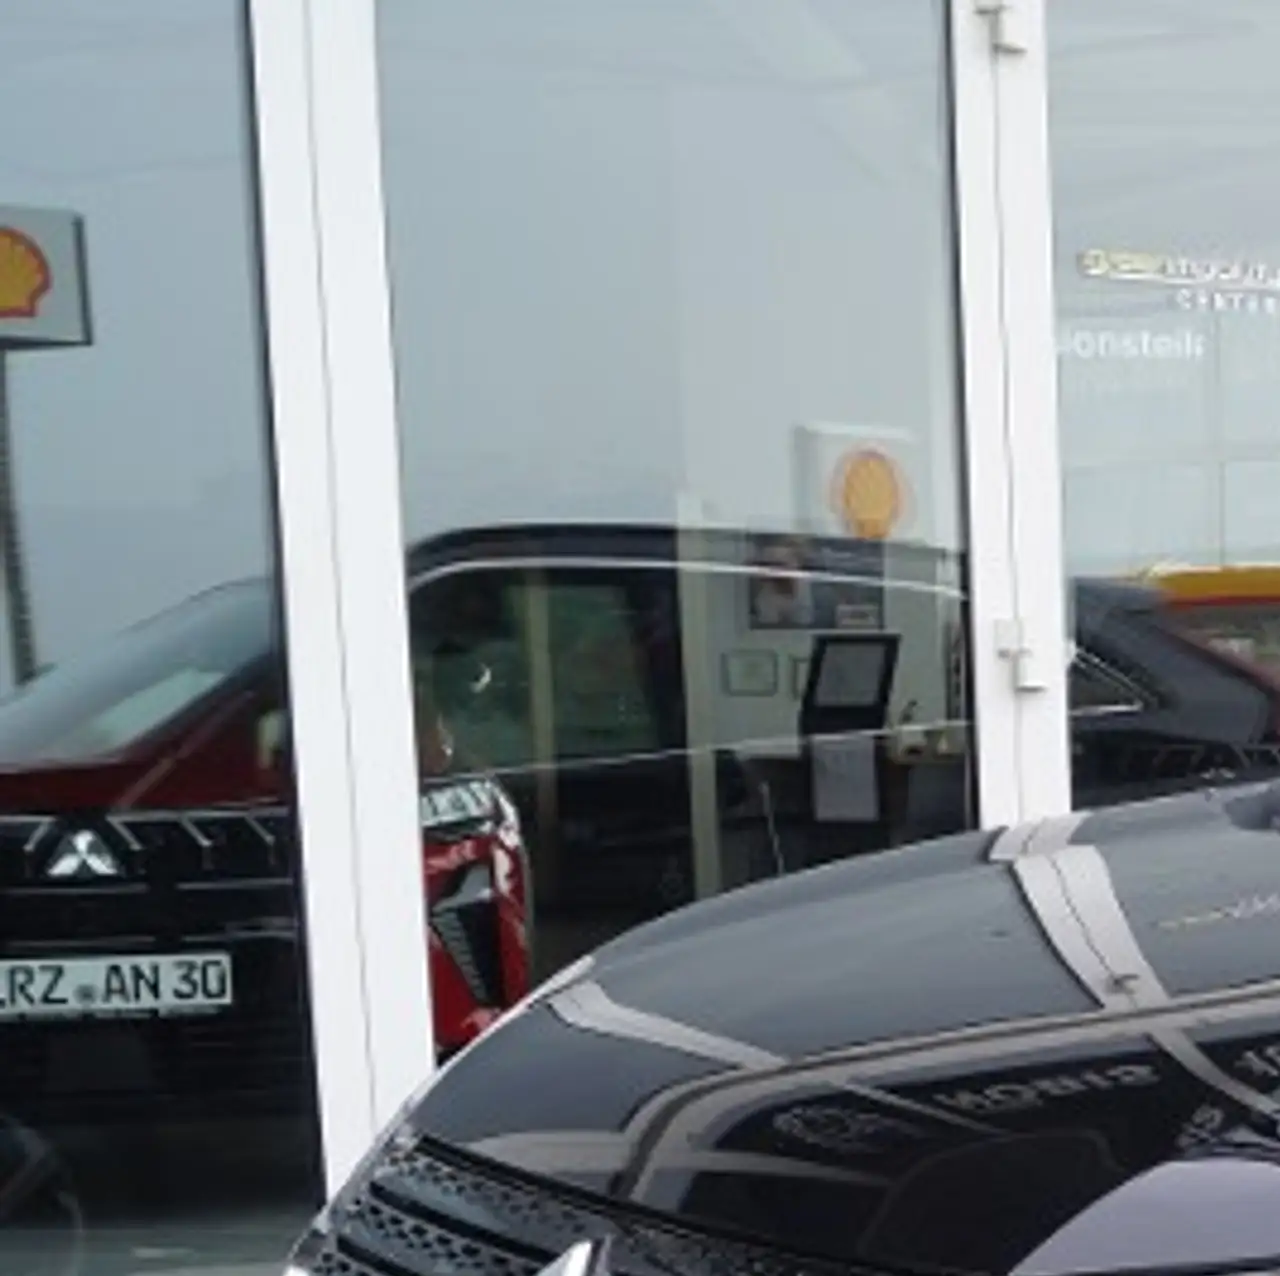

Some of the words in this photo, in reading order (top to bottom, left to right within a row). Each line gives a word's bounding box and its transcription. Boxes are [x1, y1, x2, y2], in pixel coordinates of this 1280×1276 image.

[0, 963, 69, 1006] RZ
[101, 963, 162, 1003] AN
[172, 959, 228, 1001] 30
